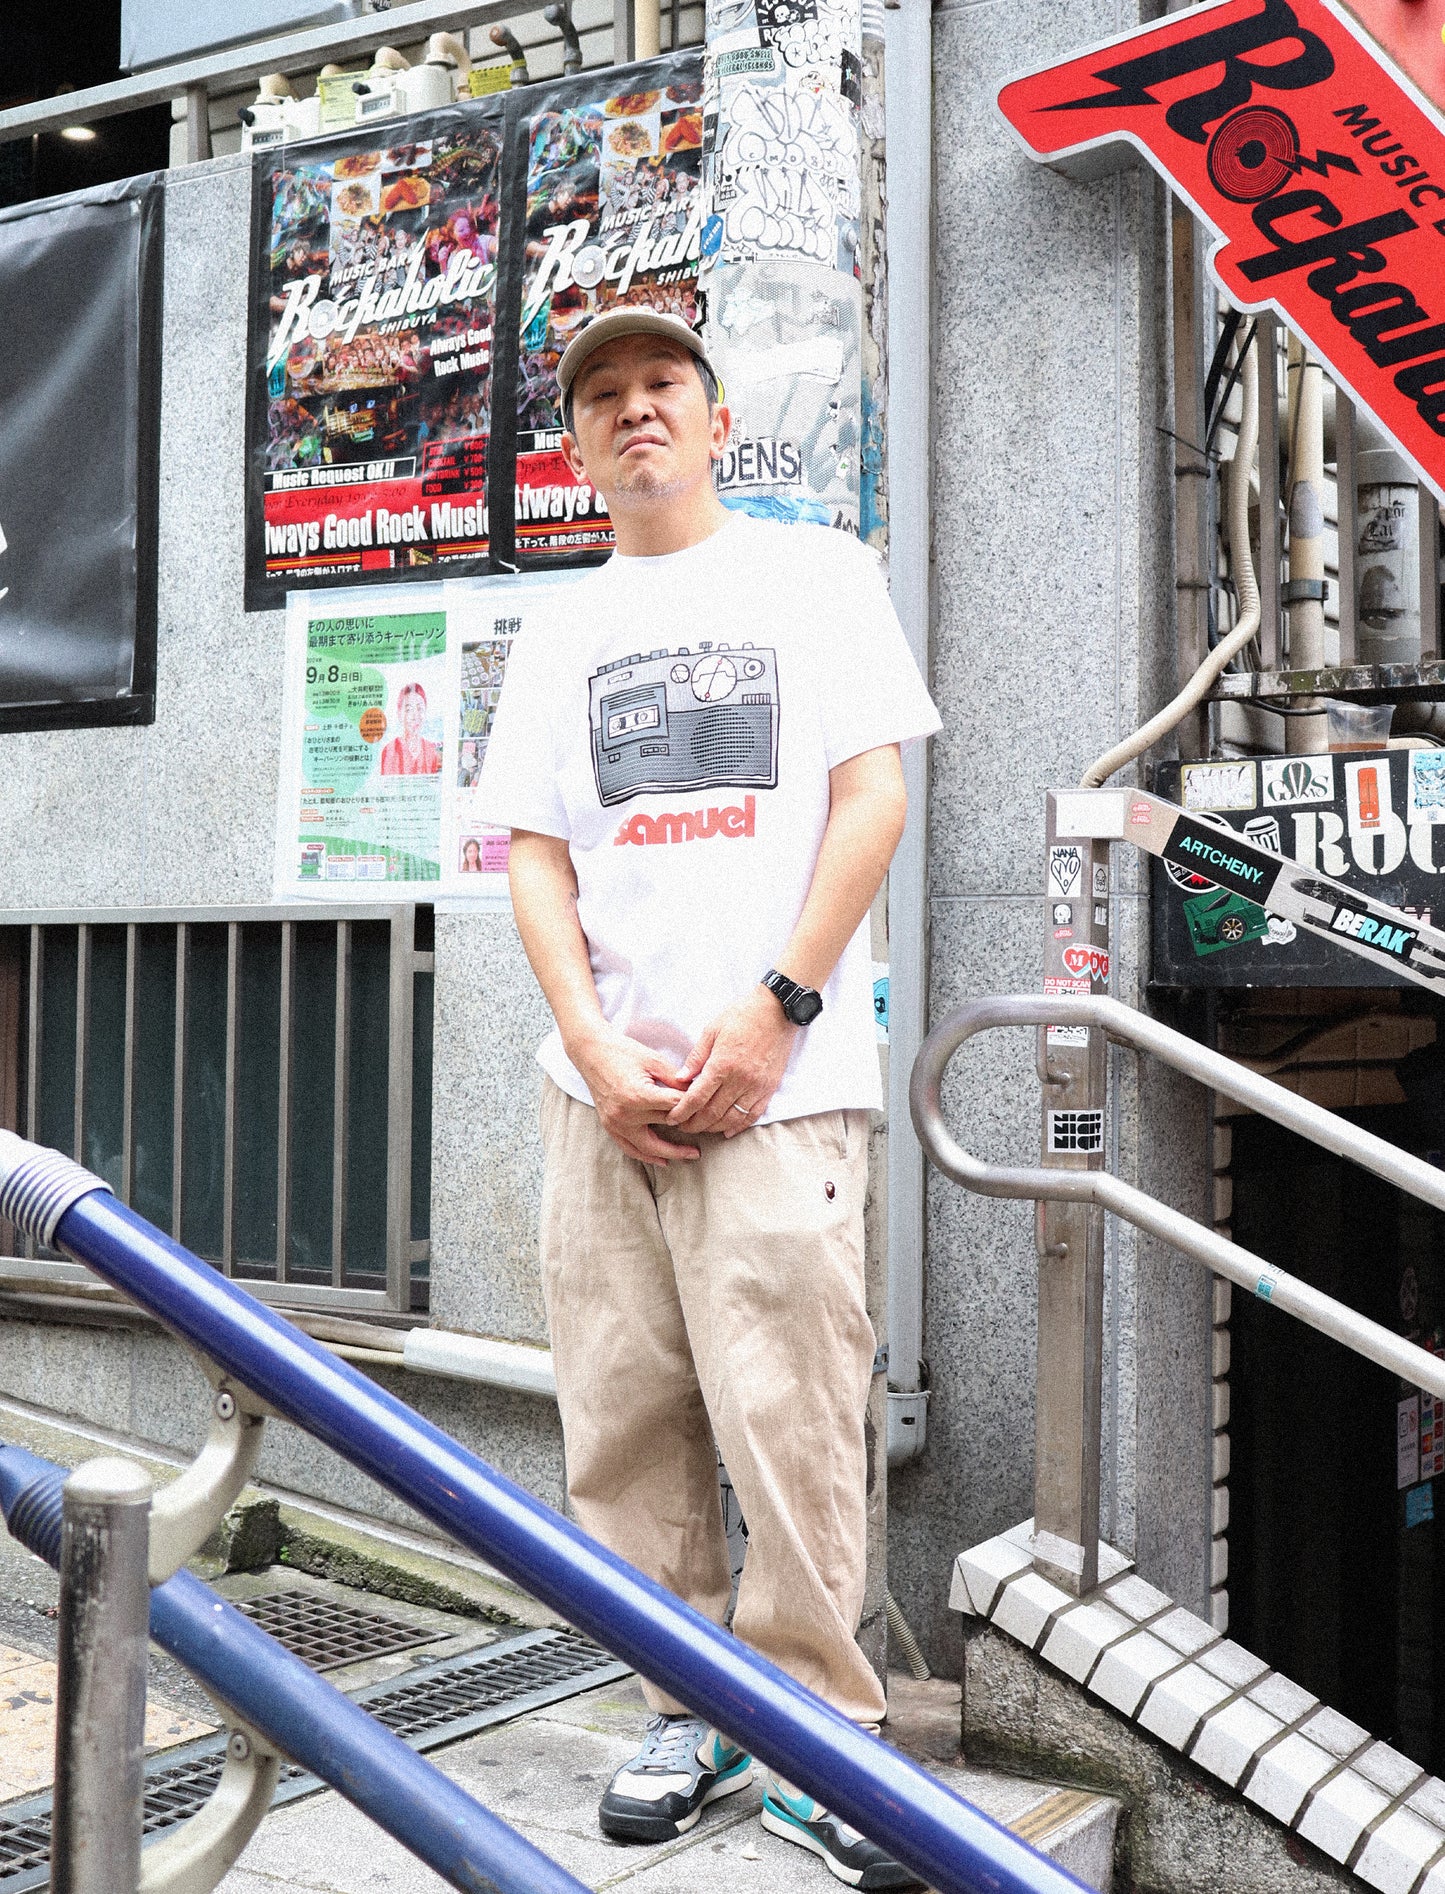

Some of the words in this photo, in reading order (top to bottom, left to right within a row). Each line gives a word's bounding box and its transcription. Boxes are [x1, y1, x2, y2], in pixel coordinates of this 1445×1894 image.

[1333, 103, 1445, 209] MUSIC
[600, 208, 651, 232] MUSIC
[653, 198, 692, 219] BAR
[329, 264, 375, 288] MUSIC
[378, 252, 412, 273] BAR
[266, 227, 498, 378] Rockaholic
[379, 312, 437, 336] SHIBUYA
[430, 334, 467, 357] Always
[467, 324, 493, 346] Good
[434, 357, 459, 378] Rock
[460, 349, 490, 371] Music
[534, 432, 562, 450] Mus
[273, 470, 309, 490] Music
[311, 467, 365, 486] Request
[367, 462, 396, 480] OK!!
[323, 510, 373, 550] Good
[376, 505, 429, 545] Rock
[308, 617, 375, 634] その人の思いに
[309, 628, 445, 649] 最期まで寄り添うキーパーソン
[1052, 846, 1078, 859] NANA
[1044, 978, 1056, 986] DO
[1056, 979, 1071, 987] NOT
[1072, 979, 1091, 988] SCAN
